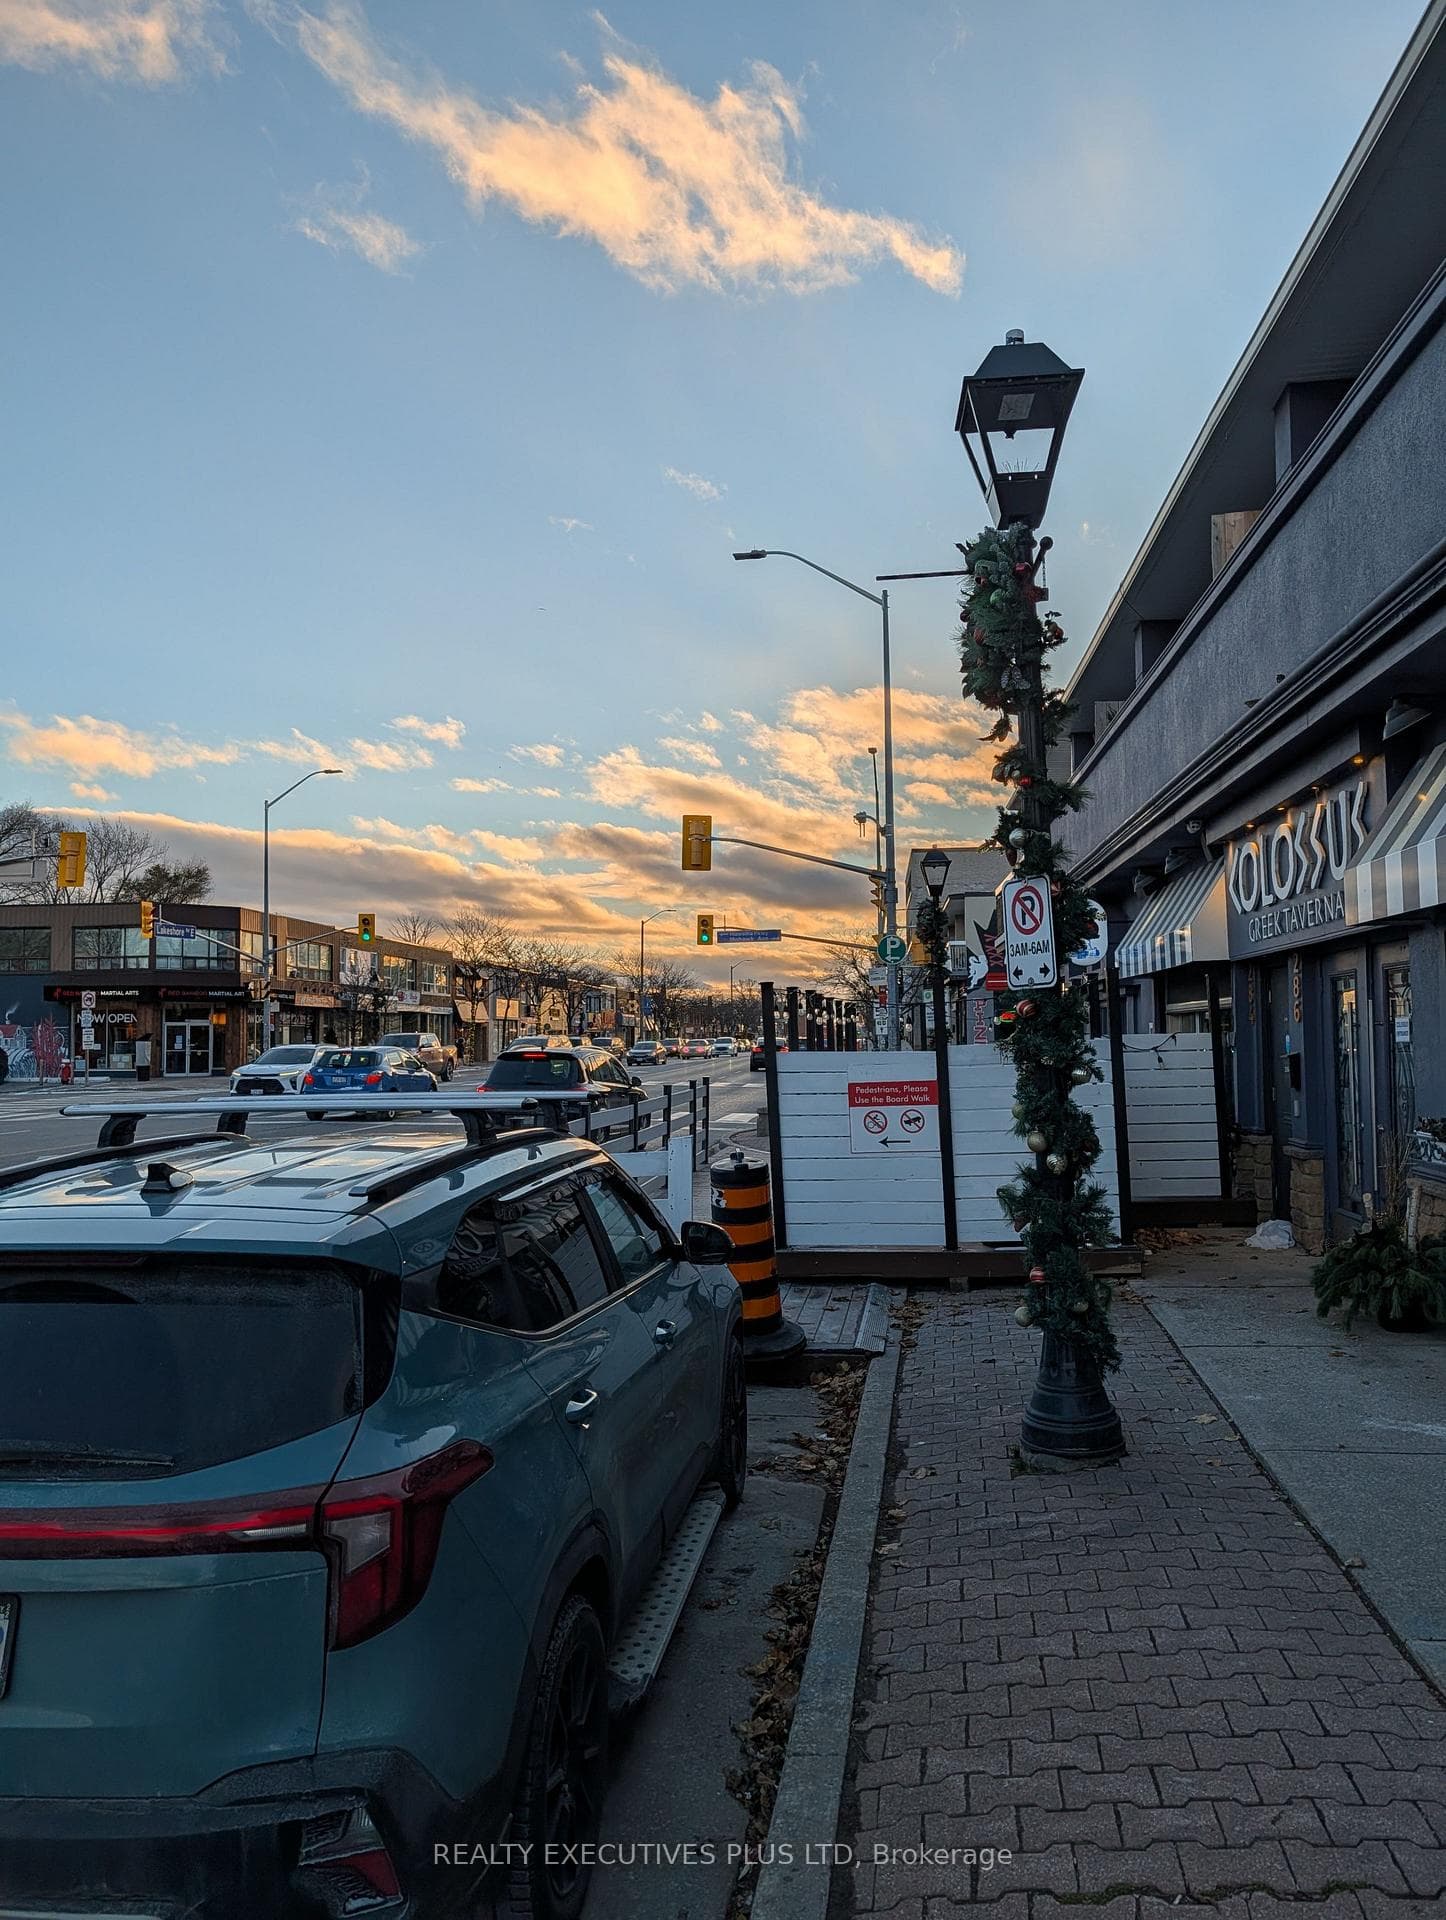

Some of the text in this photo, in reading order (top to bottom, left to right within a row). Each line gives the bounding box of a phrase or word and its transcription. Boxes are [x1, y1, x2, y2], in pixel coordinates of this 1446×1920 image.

[1248, 889, 1345, 943] GREEK TAVERNA
[156, 925, 185, 937] Lakeshore
[190, 928, 195, 937] E
[886, 938, 901, 955] P
[1009, 939, 1051, 958] 3AM-6AM
[1293, 953, 1301, 1024] 286
[855, 1084, 928, 1094] Pedestrians, Please
[855, 1096, 870, 1104] Use
[886, 1095, 909, 1103] Board
[911, 1094, 931, 1102] Walk
